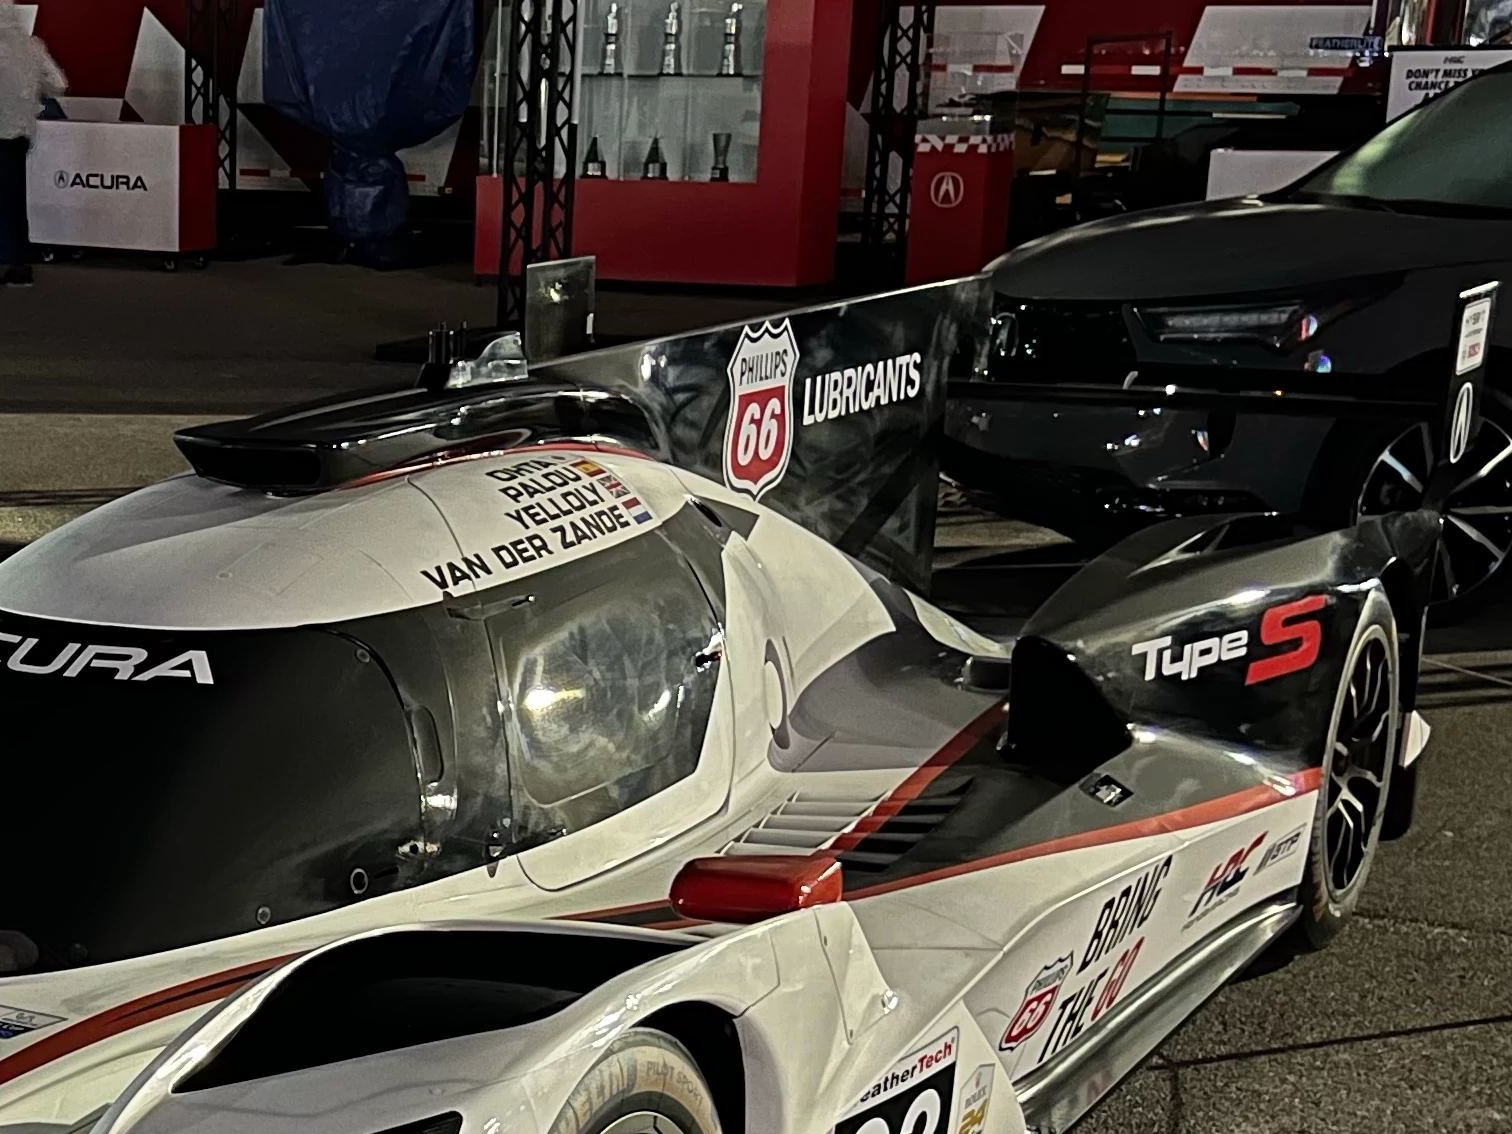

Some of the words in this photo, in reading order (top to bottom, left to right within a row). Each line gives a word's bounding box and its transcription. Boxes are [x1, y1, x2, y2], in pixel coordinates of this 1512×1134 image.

[1405, 68, 1441, 80] DON'T
[1441, 68, 1469, 79] MISS
[70, 172, 148, 192] ACURA
[738, 348, 789, 387] PHILLIPS
[802, 351, 922, 426] LUBRICANTS
[737, 397, 782, 467] 66
[498, 466, 582, 504] PALOU
[504, 482, 605, 530] YELLOLY
[420, 552, 493, 591] VAN
[490, 533, 554, 570] DER
[549, 504, 631, 551] ZANDE
[1131, 629, 1249, 682] Type
[1244, 594, 1329, 687] S
[1075, 853, 1174, 975] BRING
[1010, 992, 1054, 1038] 66
[1036, 966, 1111, 1065] THE
[860, 1040, 954, 1103] eatherTech
